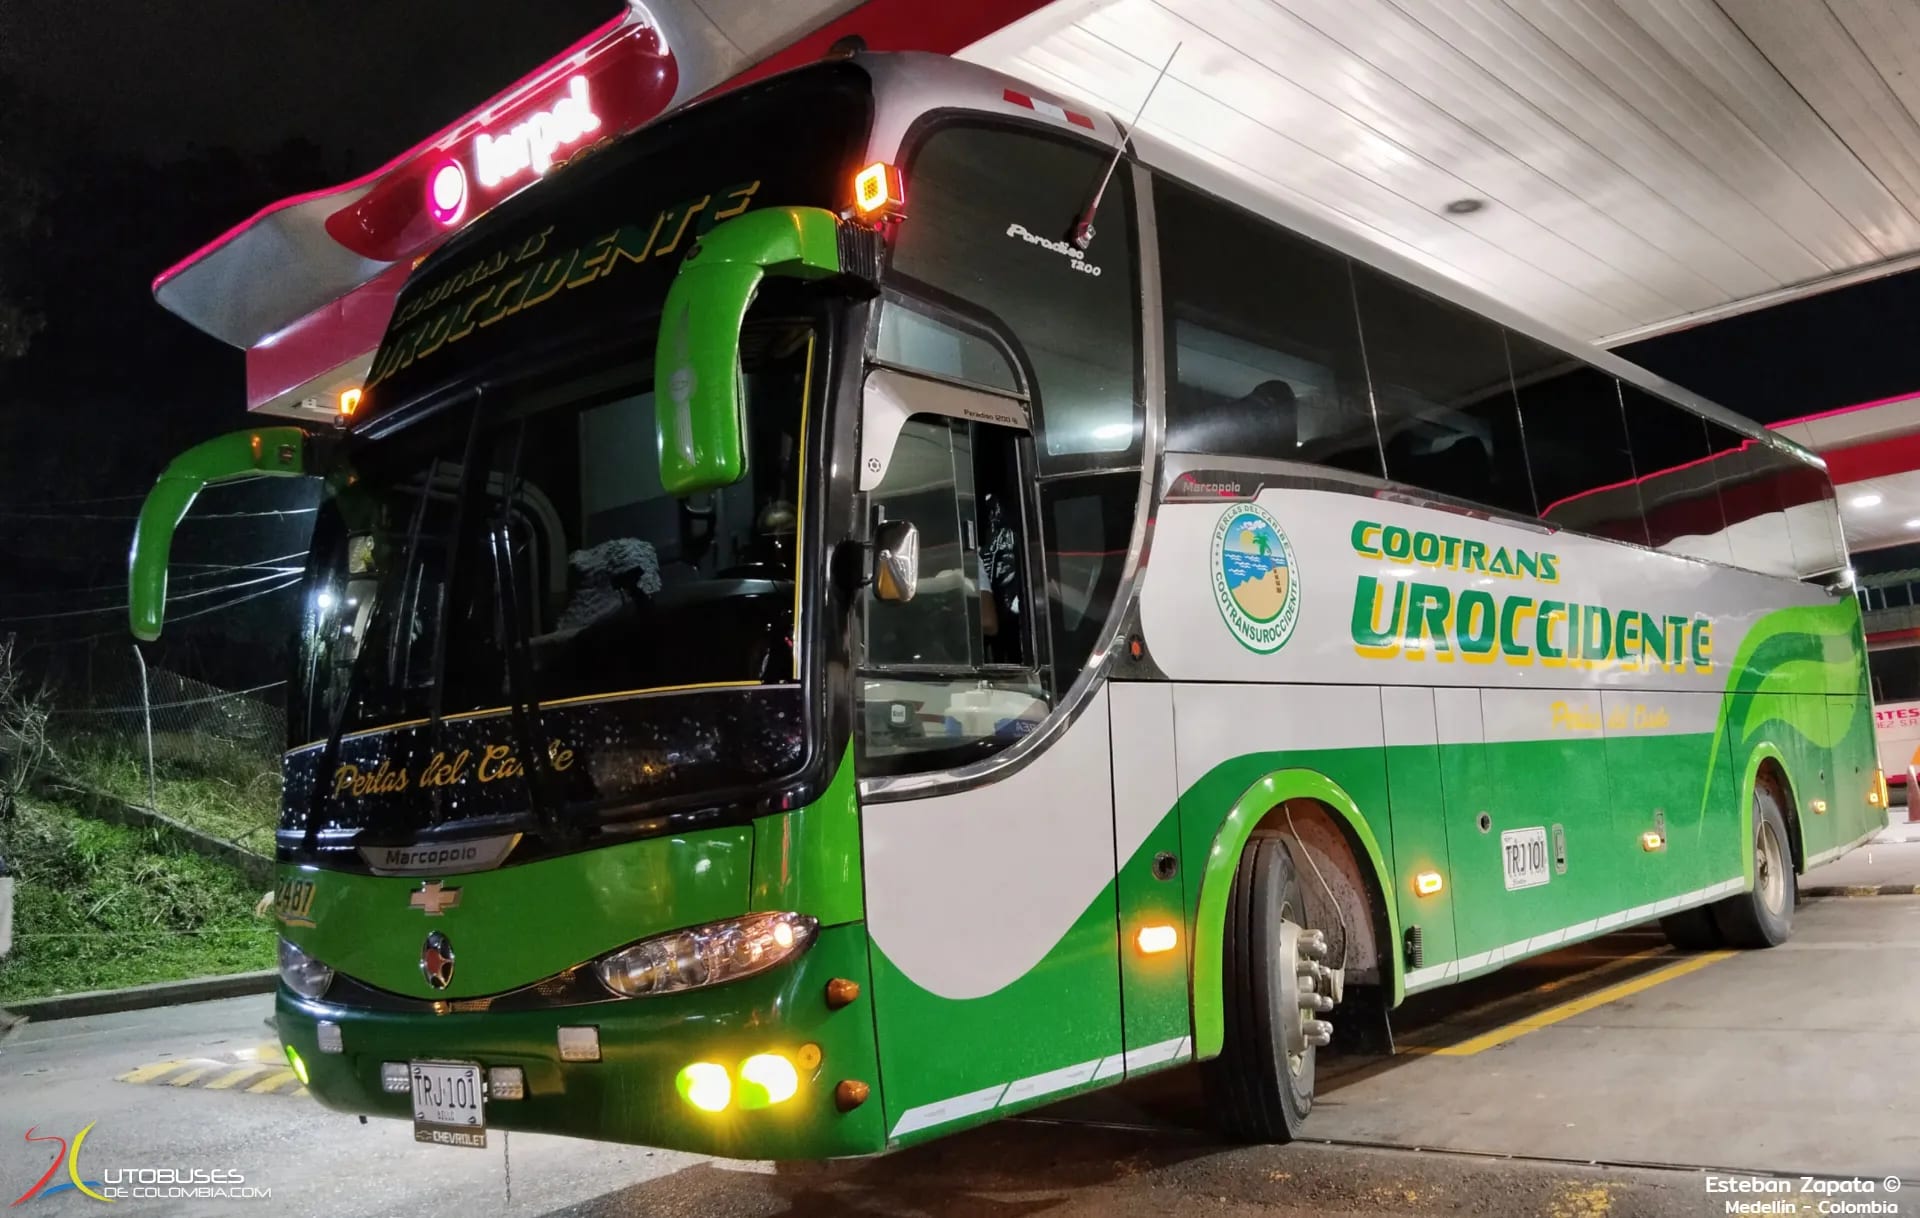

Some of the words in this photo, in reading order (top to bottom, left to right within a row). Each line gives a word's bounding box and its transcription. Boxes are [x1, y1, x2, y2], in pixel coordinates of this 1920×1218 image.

[1006, 223, 1085, 260] Paradiso
[1070, 259, 1102, 276] 1200
[1182, 481, 1241, 493] Marcopolo
[1216, 505, 1243, 541] PERLAS
[1244, 504, 1260, 515] DEL
[1261, 510, 1290, 549] CARIBE
[1351, 520, 1560, 584] COOTRANS
[1215, 571, 1298, 644] COOTRANSUROCCIDENTE
[1350, 574, 1714, 674] UROCCIDENTE
[335, 760, 410, 800] Perlas
[419, 749, 470, 788] del
[385, 846, 477, 866] Marcopolo
[433, 1130, 485, 1147] CHEVROLET
